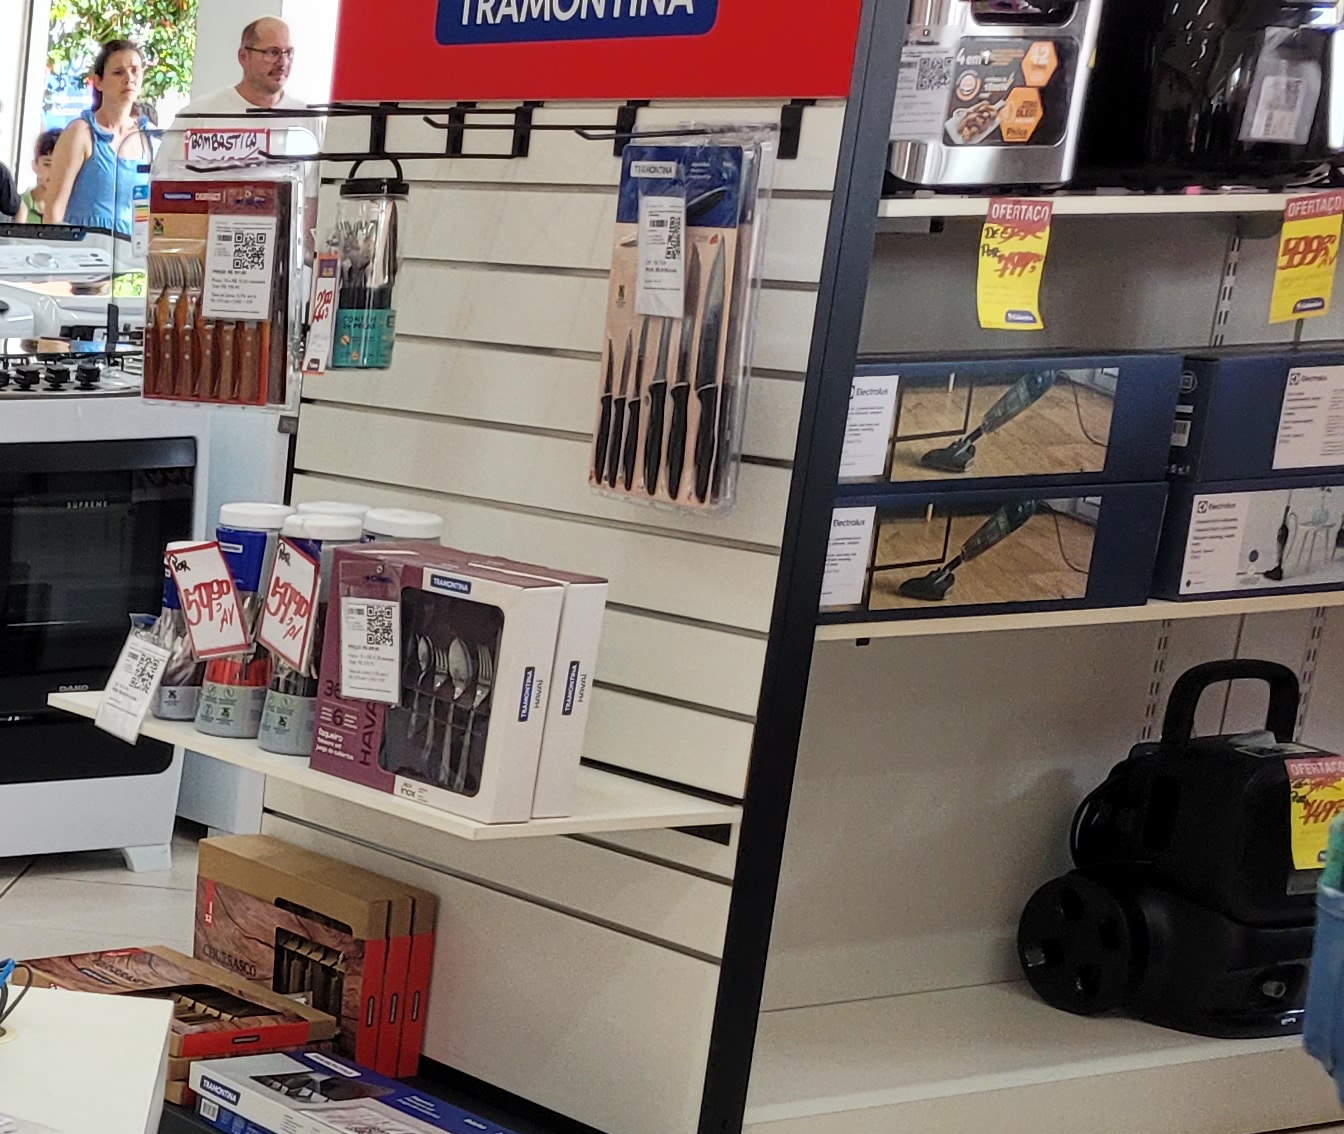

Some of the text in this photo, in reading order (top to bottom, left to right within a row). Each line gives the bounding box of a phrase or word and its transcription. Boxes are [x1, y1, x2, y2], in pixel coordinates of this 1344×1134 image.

[634, 165, 673, 174] TRAMONTINA
[856, 388, 889, 396] Electrolux
[67, 501, 108, 509] SUPREME
[833, 519, 866, 527] Electrolux
[168, 554, 190, 573] POR
[432, 576, 470, 592] TRAMONTINA
[519, 669, 534, 720] TRAMONTINA
[563, 664, 578, 713] TRAMONTINA
[333, 709, 343, 727] 6
[201, 1078, 238, 1103] TRAMONTINA
